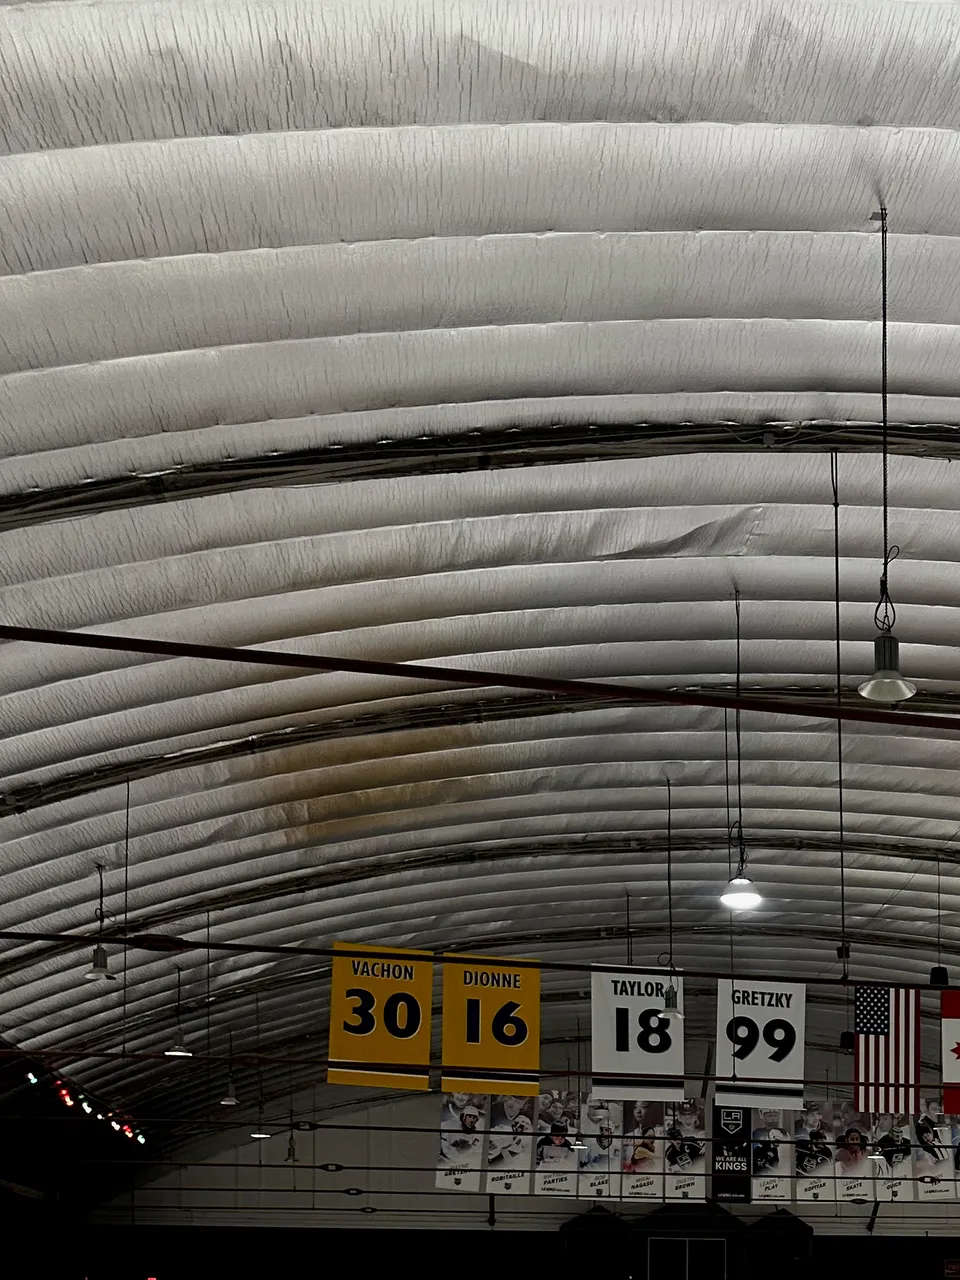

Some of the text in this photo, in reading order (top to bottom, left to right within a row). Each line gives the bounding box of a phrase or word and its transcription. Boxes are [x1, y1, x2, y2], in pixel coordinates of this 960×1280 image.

[352, 960, 414, 980] VACHON
[464, 971, 521, 989] DIONNE
[611, 980, 665, 997] TAYLOR
[732, 990, 793, 1008] GRETZKY
[343, 988, 423, 1040] 30
[466, 999, 529, 1047] 16
[616, 1007, 672, 1053] 18
[726, 1016, 796, 1062] 99
[715, 1161, 748, 1171] KINGS
[543, 1176, 568, 1185] PARTIES
[631, 1180, 655, 1189] NAGASU
[675, 1182, 695, 1190] BROWN
